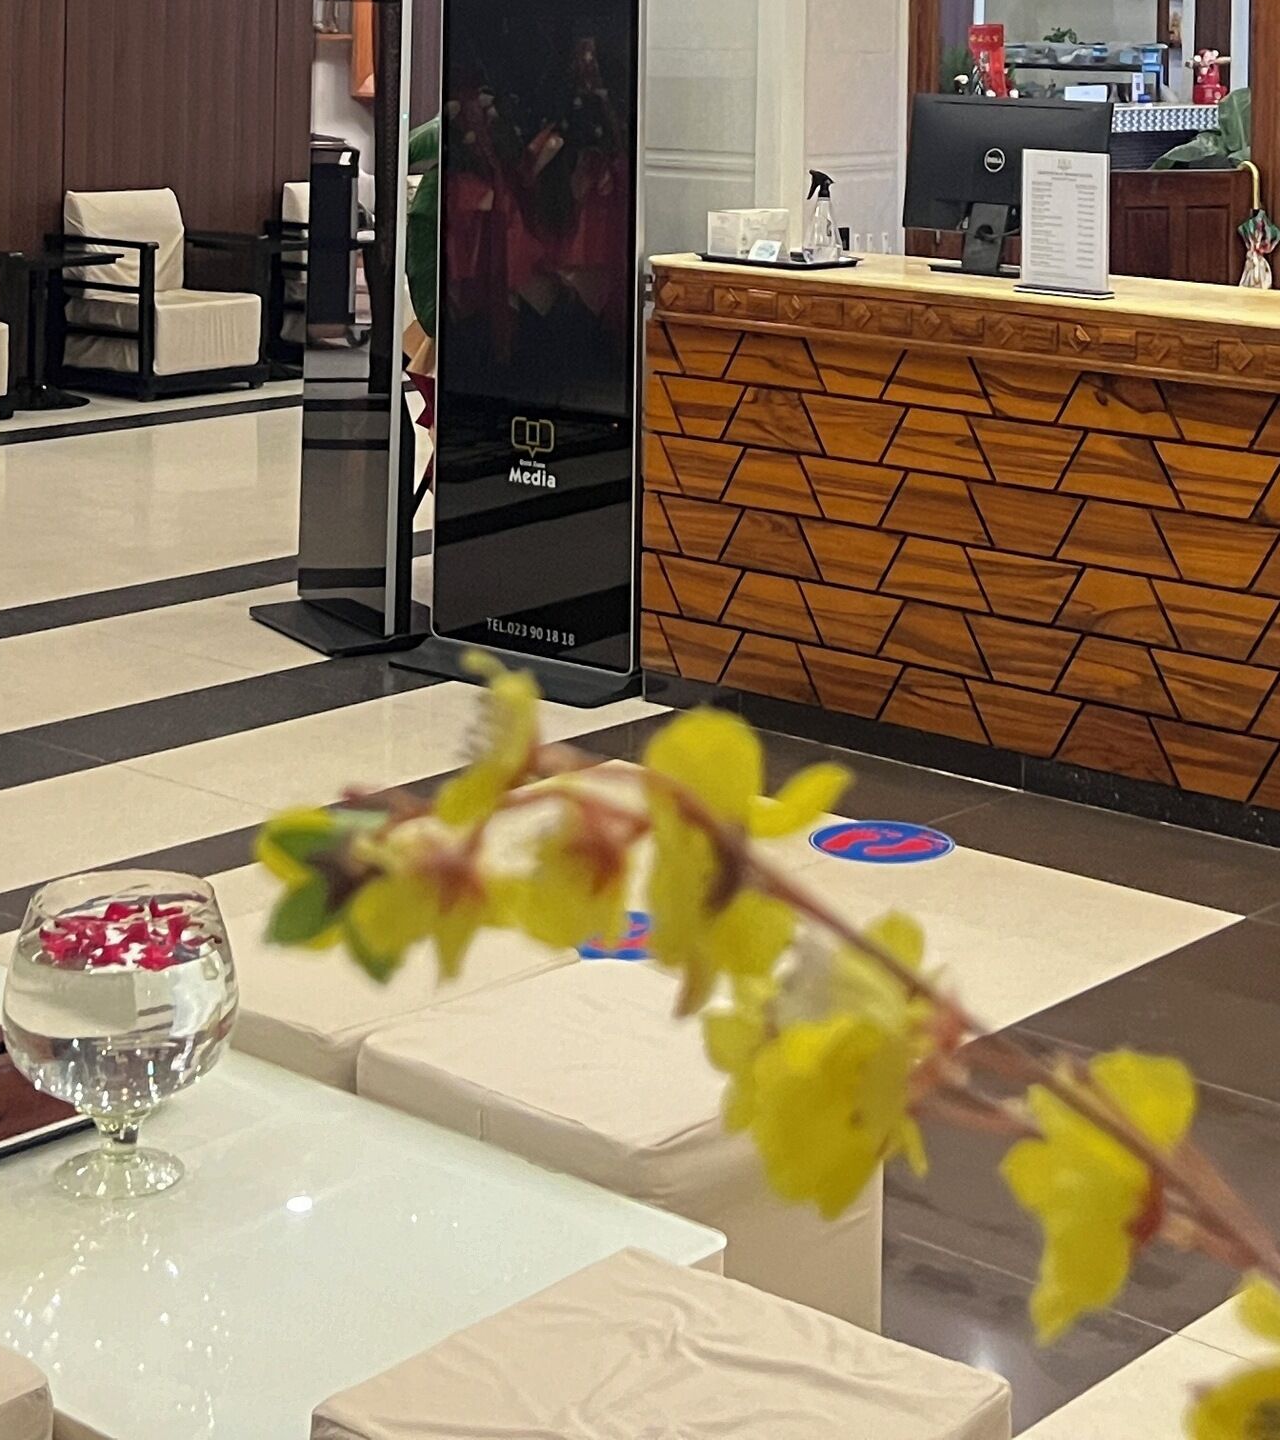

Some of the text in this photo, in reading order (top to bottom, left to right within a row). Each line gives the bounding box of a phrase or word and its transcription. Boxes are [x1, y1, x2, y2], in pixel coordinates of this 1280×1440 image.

[509, 466, 556, 489] Media
[529, 625, 544, 640] 90
[546, 629, 559, 643] 18
[561, 632, 575, 647] 18
